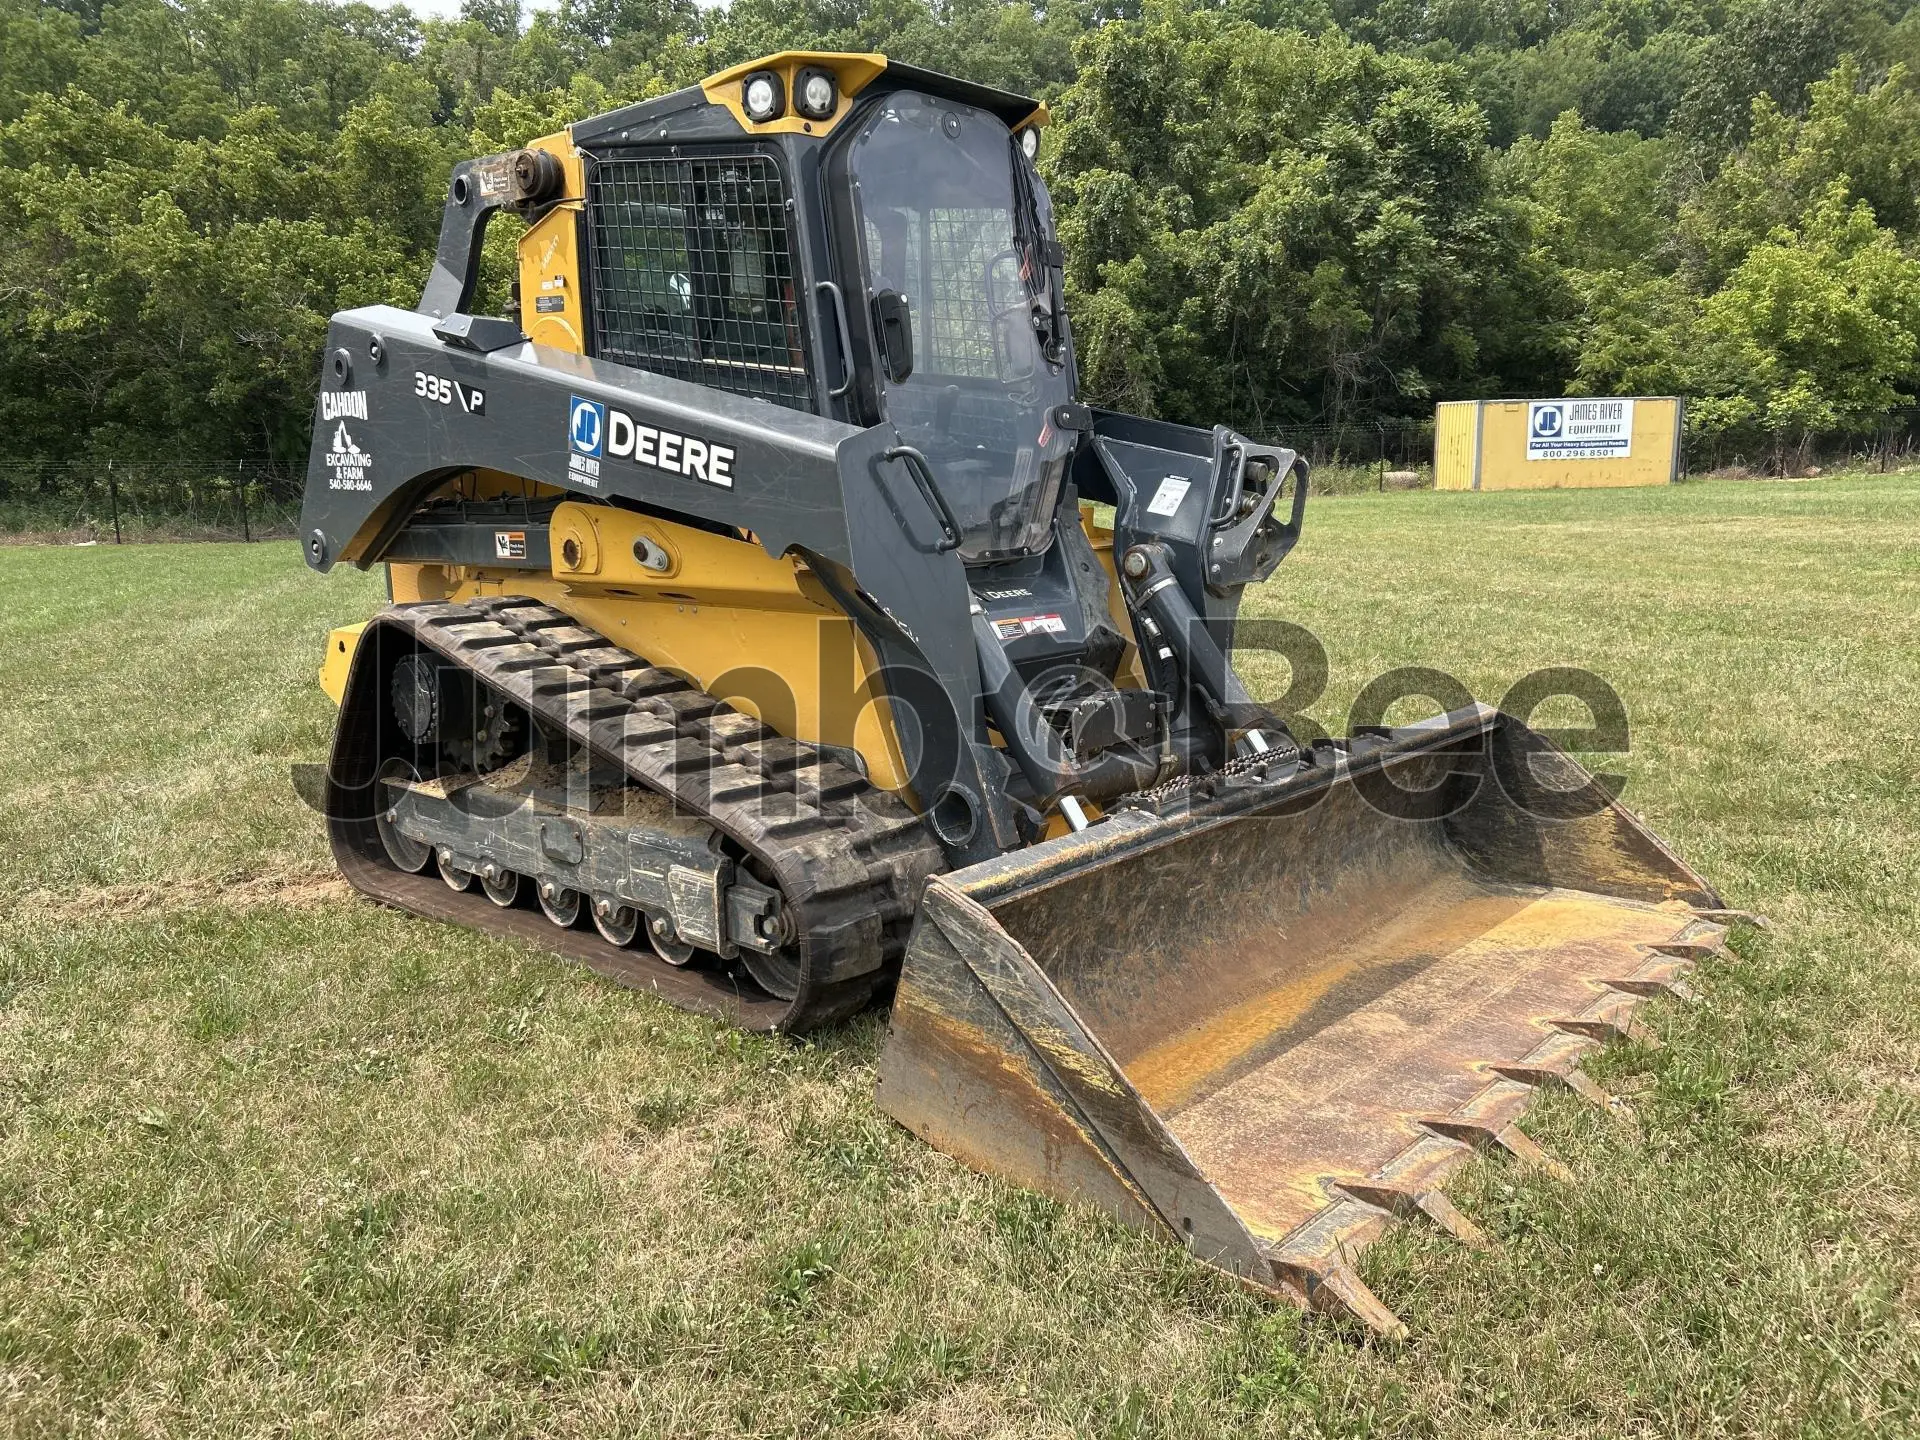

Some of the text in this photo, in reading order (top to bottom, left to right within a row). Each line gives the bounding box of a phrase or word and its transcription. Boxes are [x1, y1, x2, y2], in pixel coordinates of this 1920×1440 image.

[321, 390, 368, 420] CAHOON
[1569, 402, 1623, 420] JAMES RIVER
[1568, 423, 1622, 435] EQUIPMENT
[608, 409, 735, 488] DEERE
[1580, 440, 1608, 448] Equipment
[1542, 449, 1614, 458] 800.296.8501
[326, 453, 372, 467] EXCAVATING
[336, 467, 364, 479] & FARM
[329, 479, 372, 492] 540-580-6646
[986, 588, 1033, 599] DEERE
